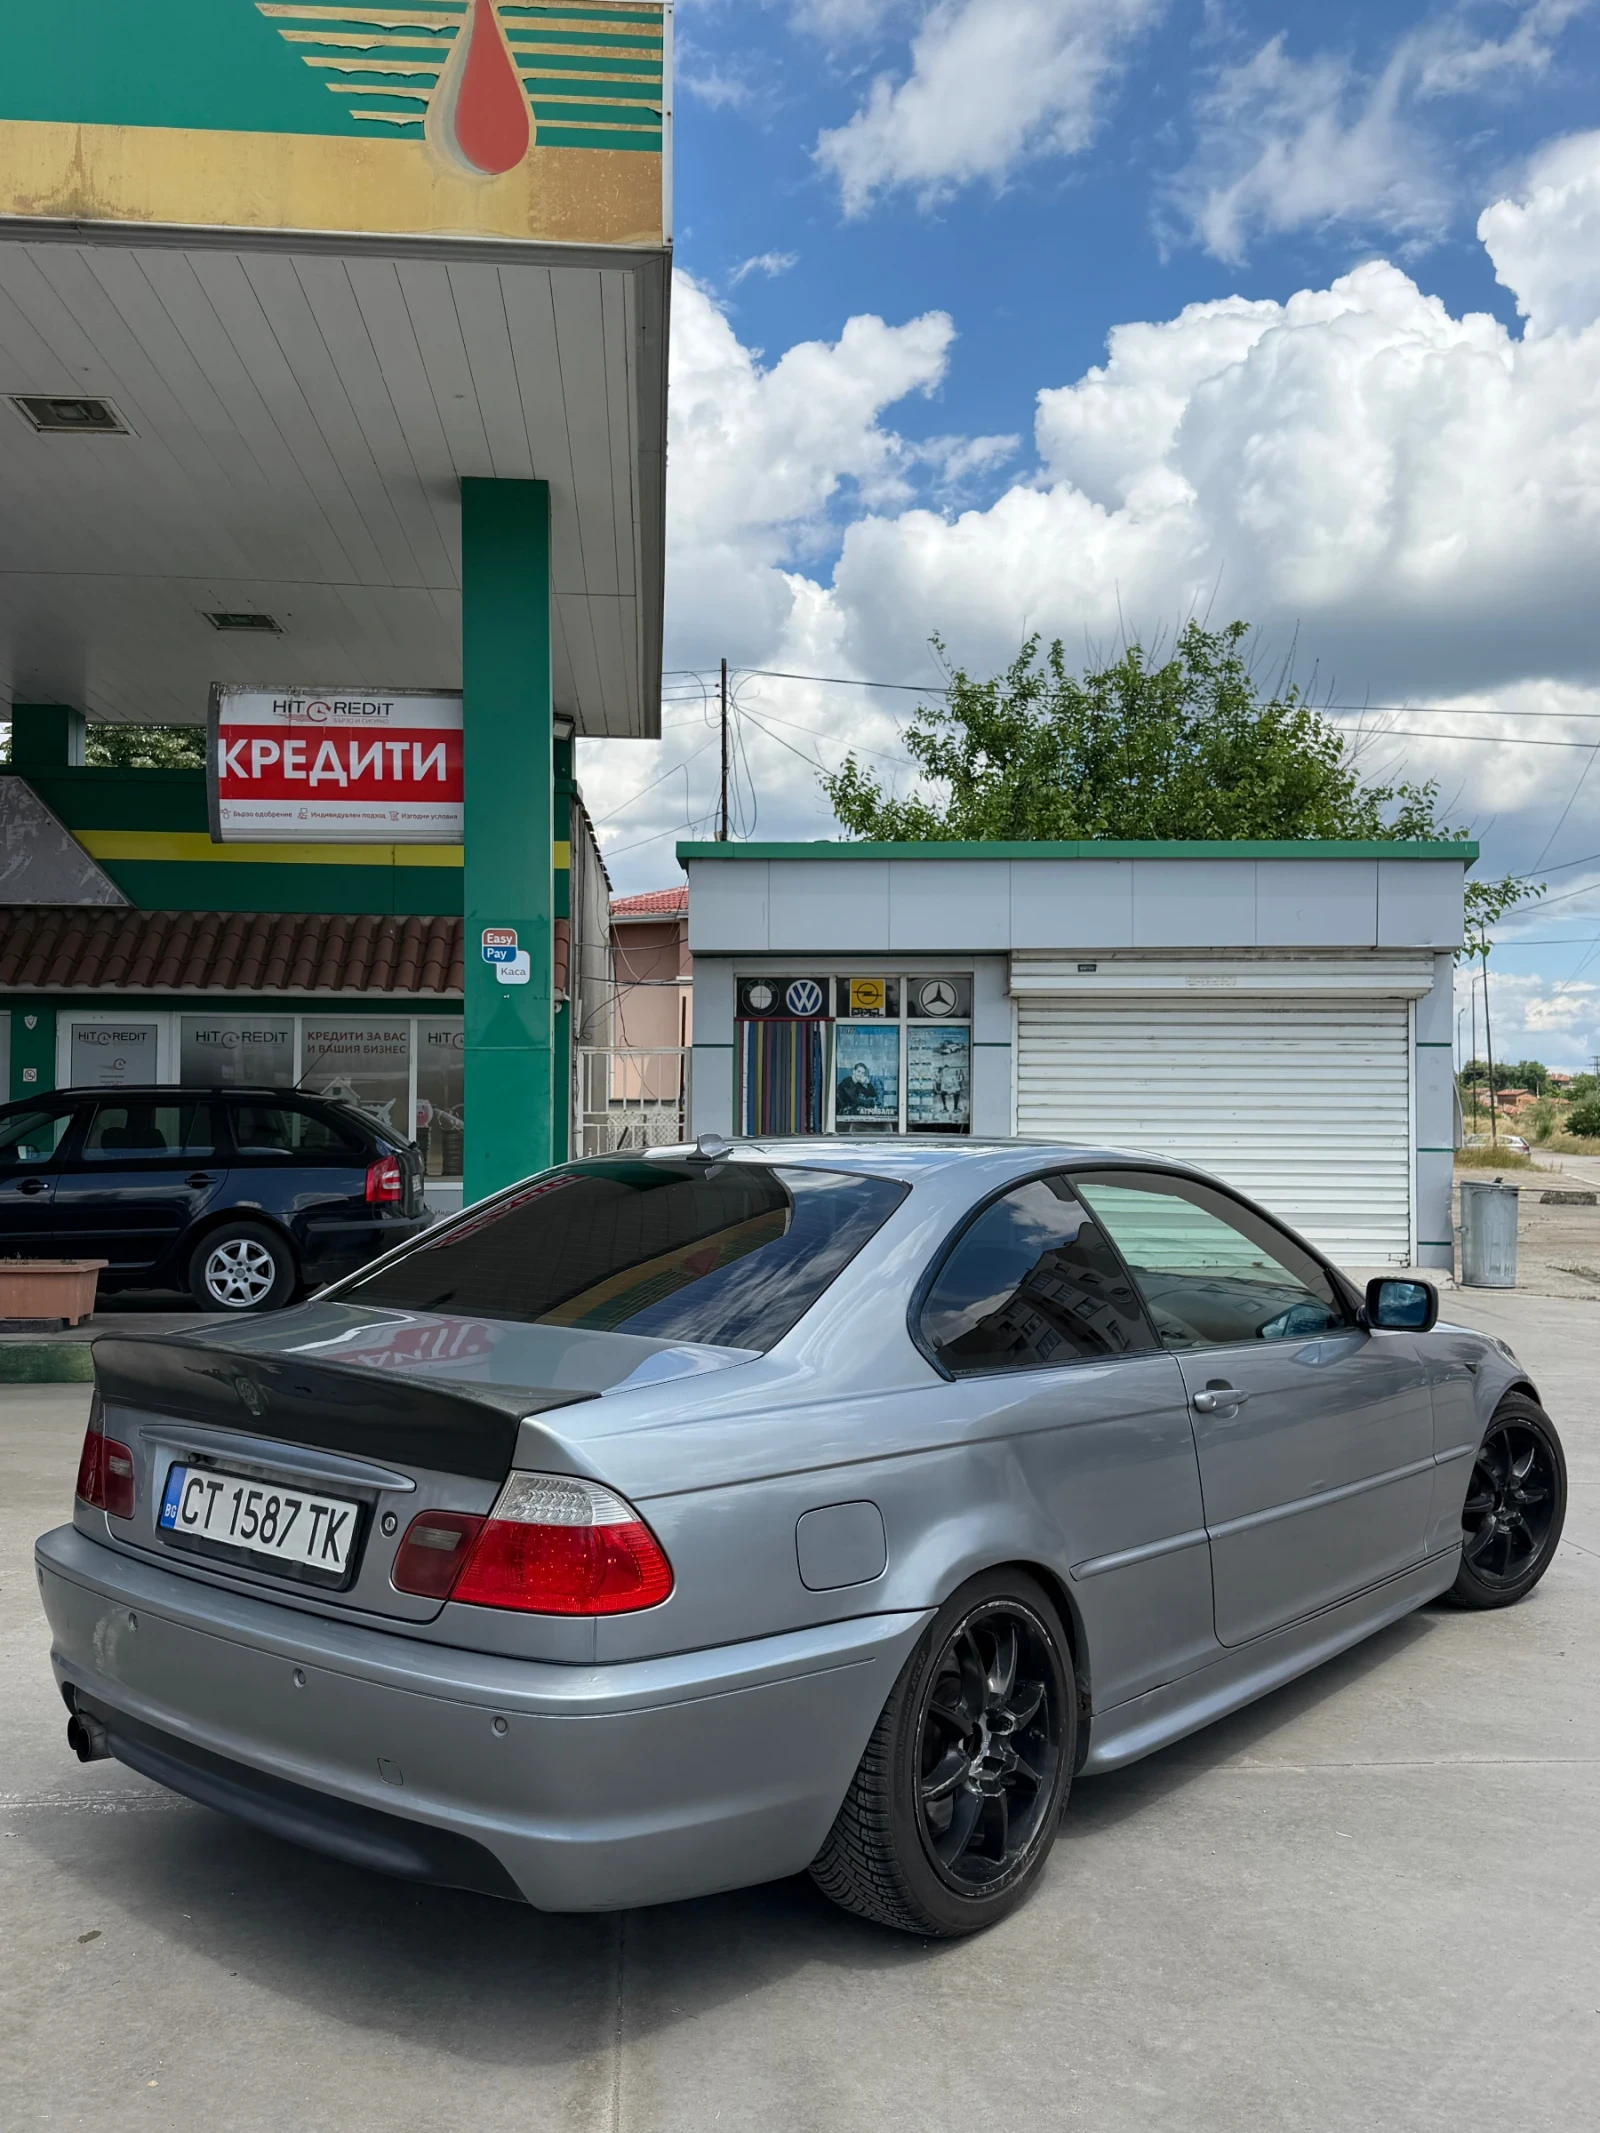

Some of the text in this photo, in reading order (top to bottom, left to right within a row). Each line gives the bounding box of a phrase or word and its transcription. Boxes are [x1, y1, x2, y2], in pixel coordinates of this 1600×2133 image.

[218, 739, 447, 787] КРЕДИТИ
[233, 810, 293, 818] Бързо одобрение
[487, 933, 512, 945] Easy
[487, 948, 507, 960] Pay
[307, 1031, 407, 1043] КРЕДИТИ ЗА ВАС
[307, 1045, 407, 1054] И ВАШИЯ БИЗНЕС
[164, 1503, 177, 1519] BG
[181, 1477, 349, 1563] CT 1587 TK
